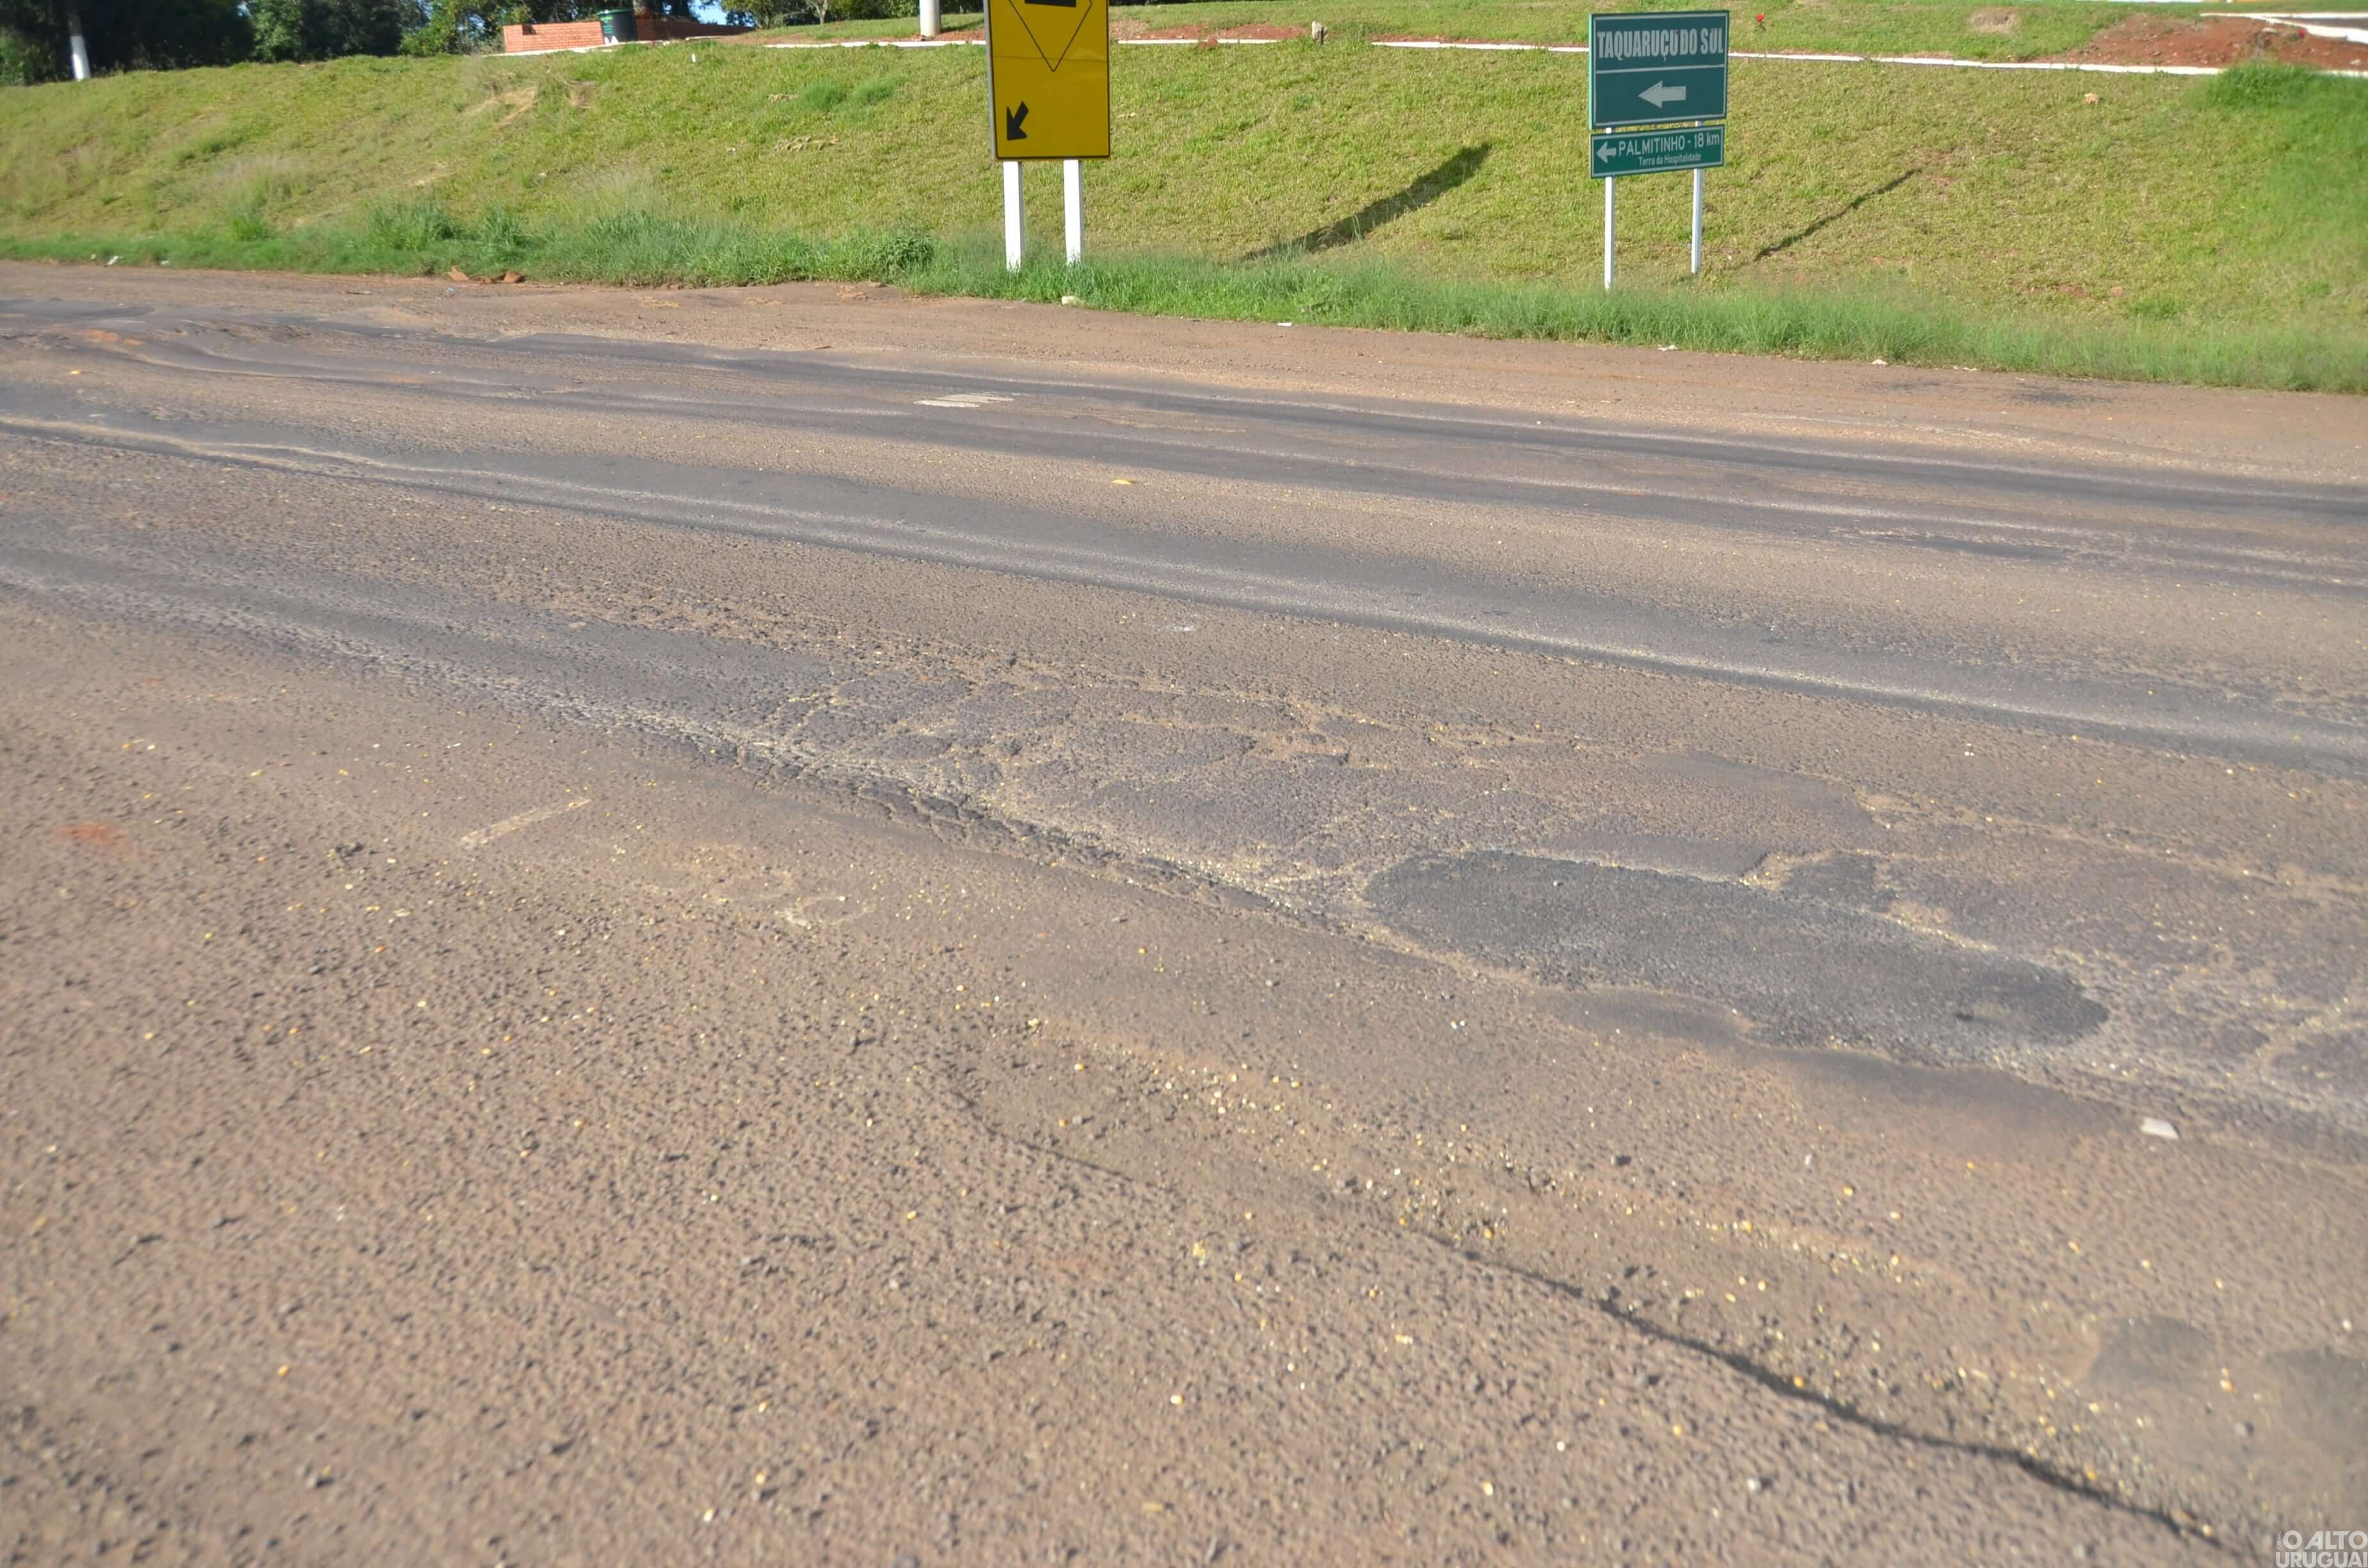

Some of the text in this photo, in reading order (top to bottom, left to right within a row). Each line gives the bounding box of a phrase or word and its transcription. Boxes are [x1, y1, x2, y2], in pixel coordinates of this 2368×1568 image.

[1680, 28, 1698, 55] DO
[1700, 28, 1723, 54] SUL
[1618, 135, 1685, 156] PALMITINHO
[1694, 133, 1704, 149] 18
[1707, 132, 1720, 146] km
[1639, 156, 1655, 166] Terra
